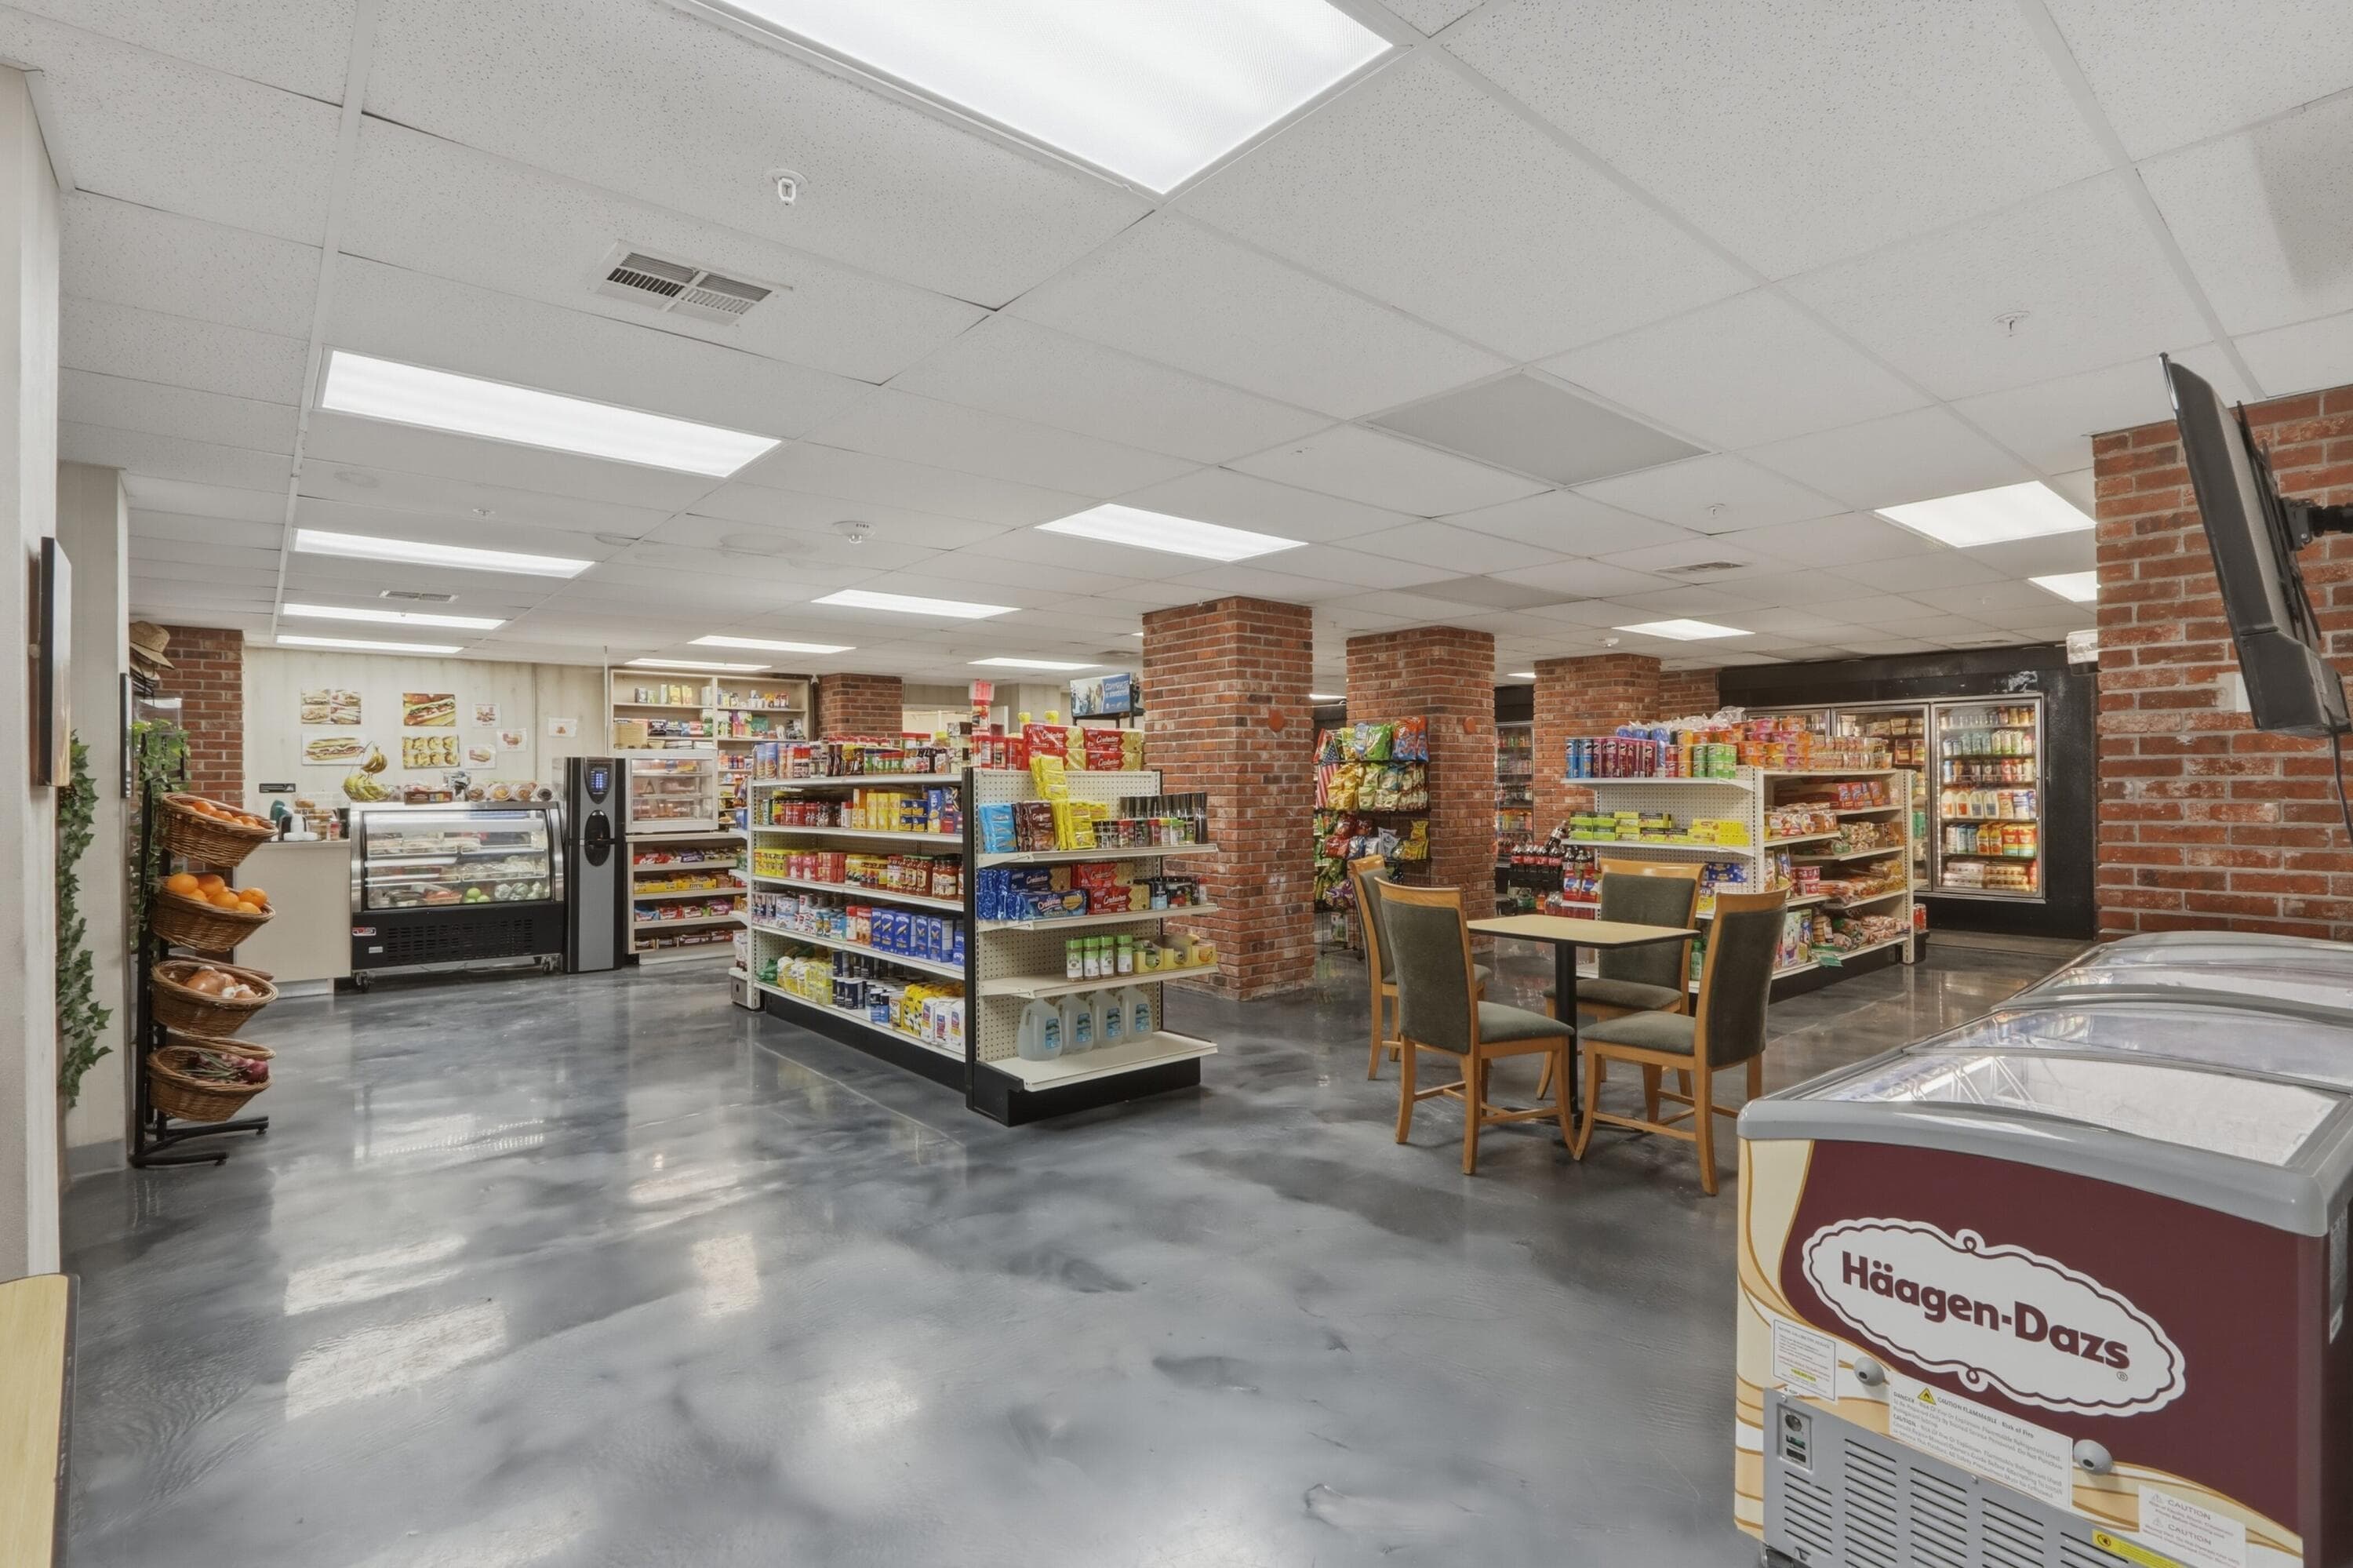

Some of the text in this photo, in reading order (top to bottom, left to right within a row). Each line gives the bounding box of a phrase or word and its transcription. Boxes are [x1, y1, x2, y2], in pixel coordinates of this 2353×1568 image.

[1842, 1250, 2130, 1370] Häagen-Dazs
[1894, 1392, 1915, 1405] DANGER
[1893, 1414, 1916, 1428] CAUTION
[1937, 1397, 1962, 1412] CAUTION
[2002, 1421, 2015, 1431] Risk
[2167, 1499, 2211, 1521] CAUTION
[2167, 1523, 2212, 1545] CAUTION
